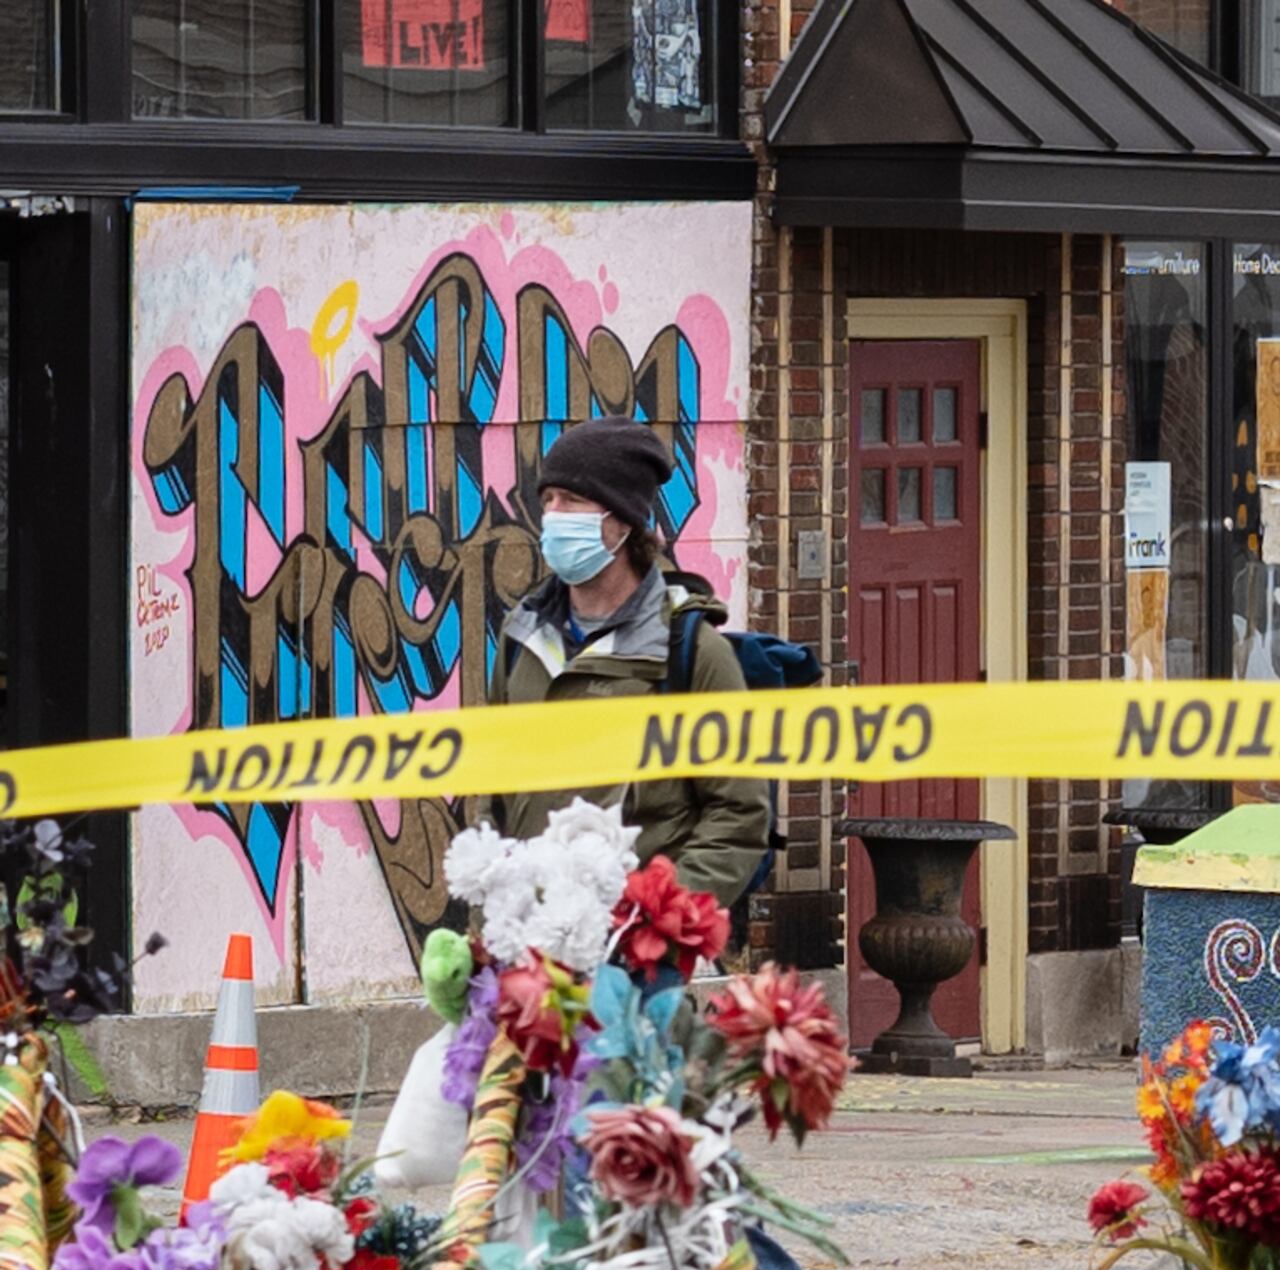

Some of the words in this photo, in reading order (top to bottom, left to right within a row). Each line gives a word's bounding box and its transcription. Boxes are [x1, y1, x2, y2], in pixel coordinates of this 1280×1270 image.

[399, 16, 480, 66] LIVE!
[185, 728, 463, 795] CAUTION
[638, 702, 934, 770] CAUTION
